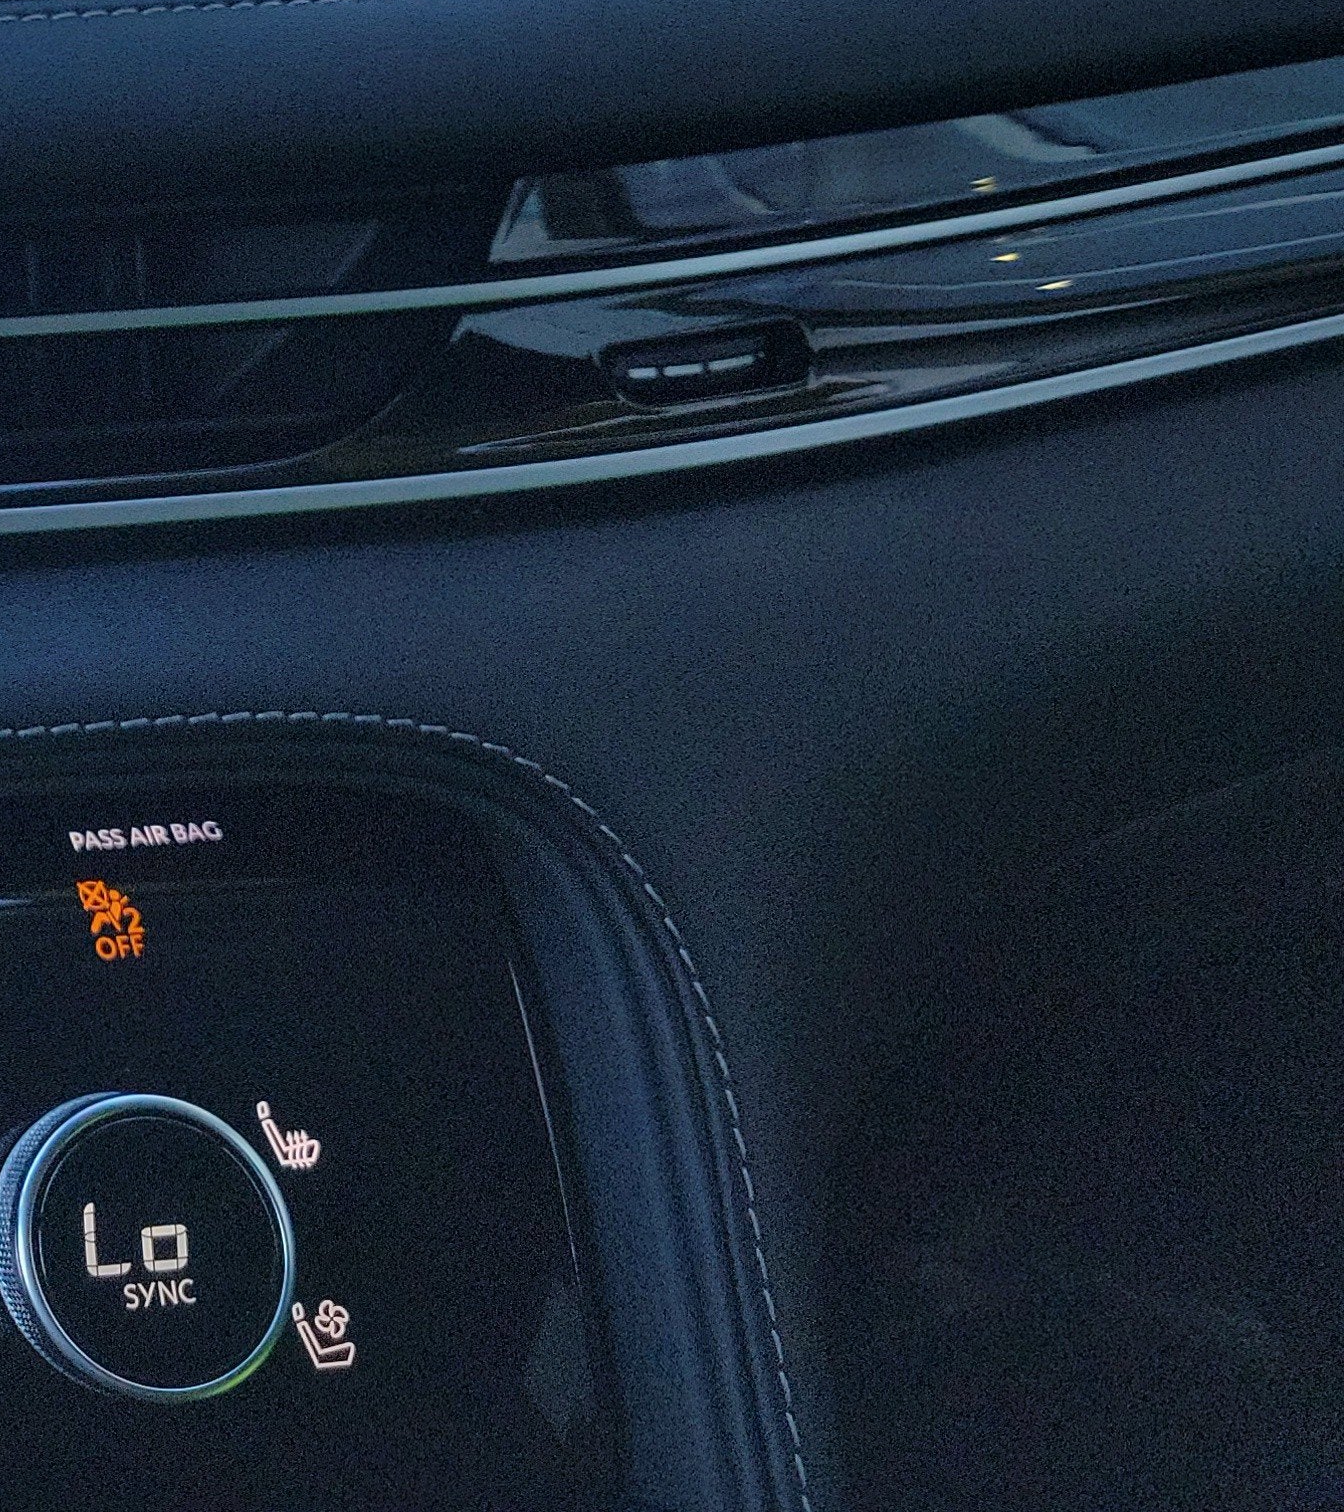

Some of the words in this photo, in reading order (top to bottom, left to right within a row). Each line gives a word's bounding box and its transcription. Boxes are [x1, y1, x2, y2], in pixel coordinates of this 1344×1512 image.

[69, 828, 127, 852] PASS
[131, 825, 170, 847] AIR
[170, 821, 223, 844] BAG
[95, 934, 144, 962] OFF
[124, 1279, 196, 1310] SYNC
